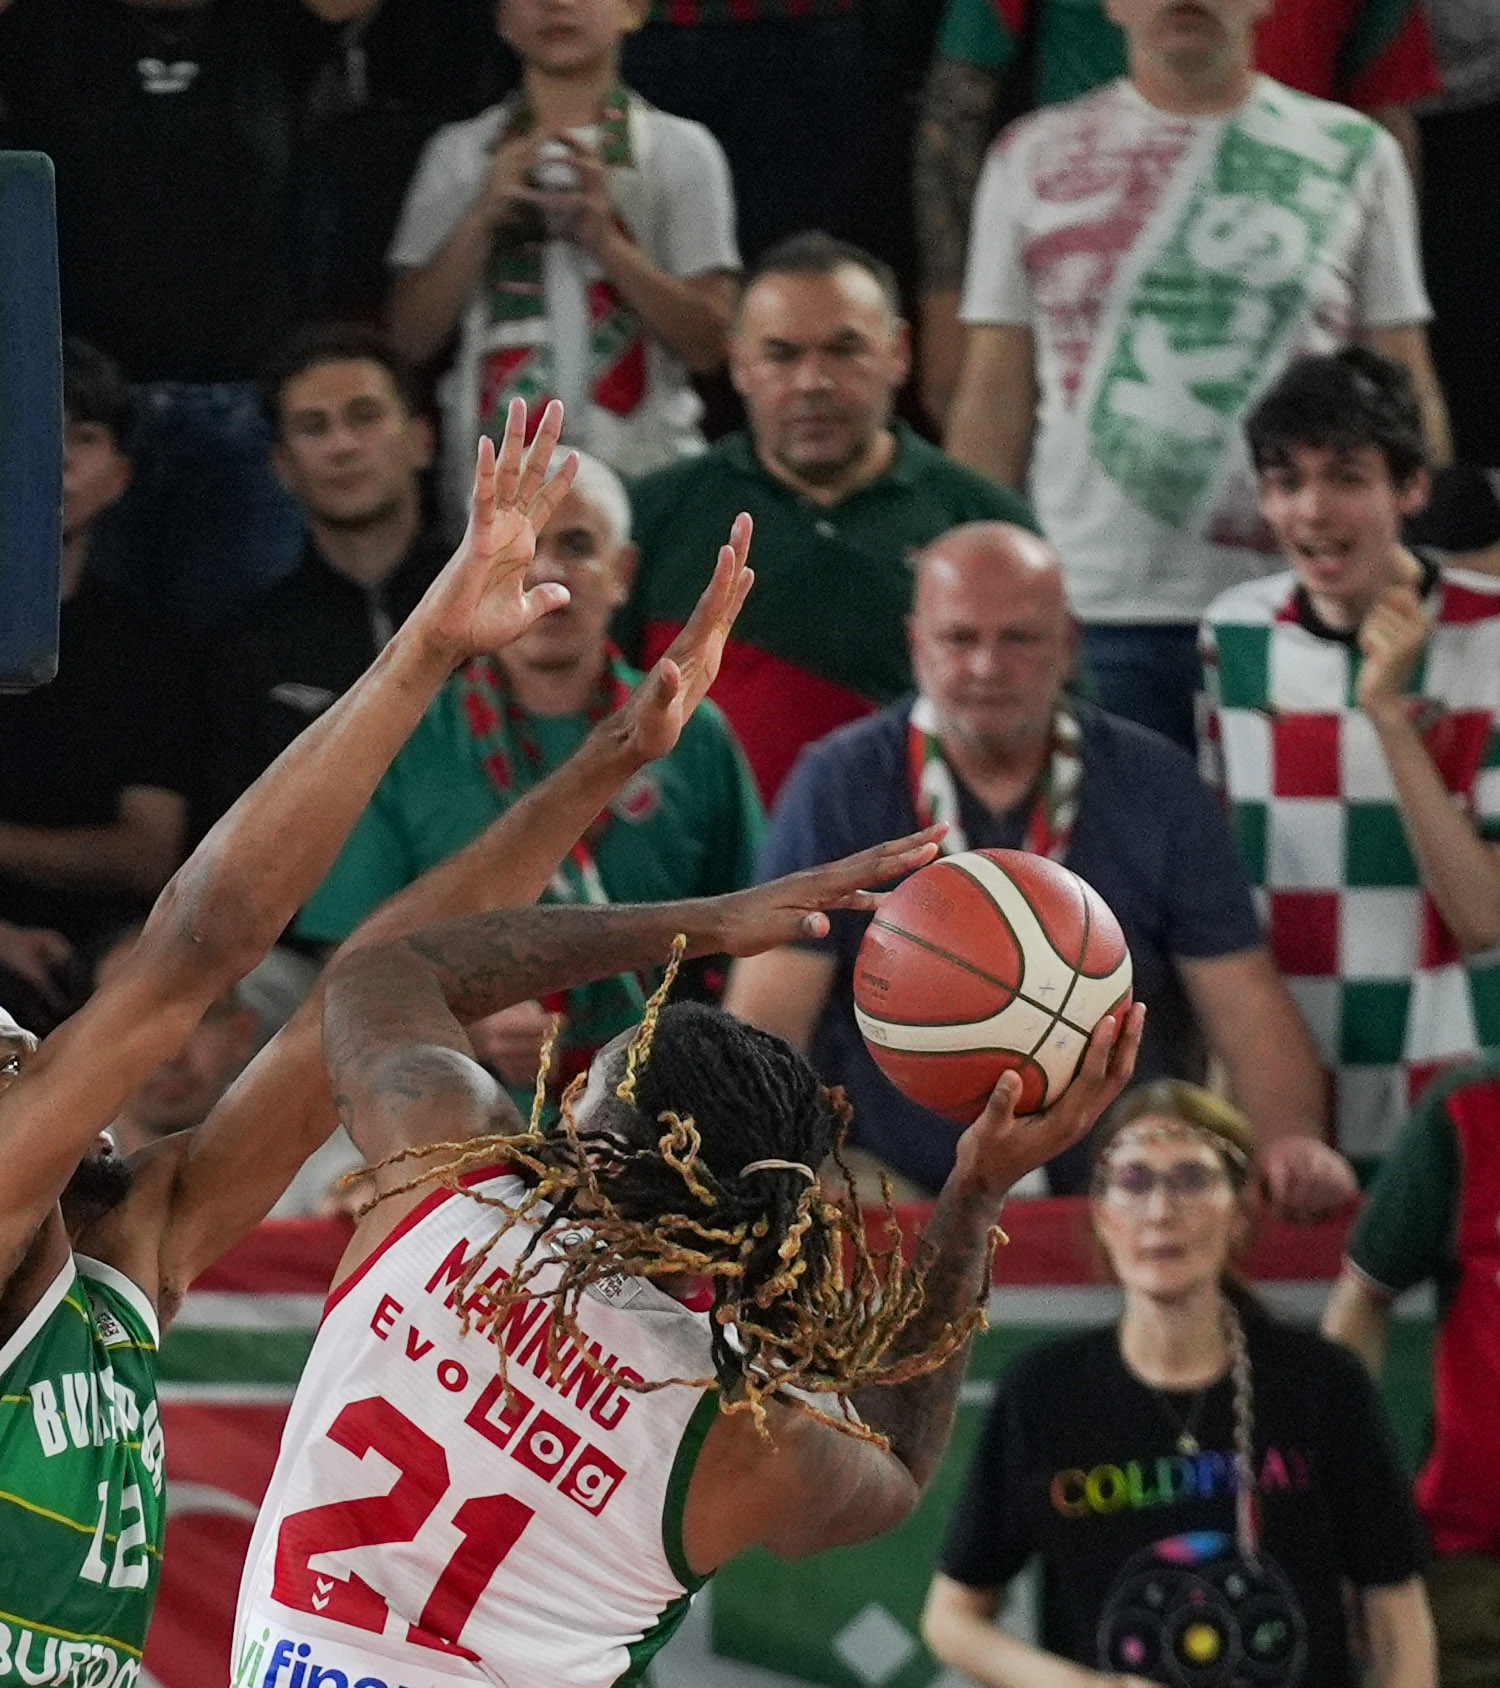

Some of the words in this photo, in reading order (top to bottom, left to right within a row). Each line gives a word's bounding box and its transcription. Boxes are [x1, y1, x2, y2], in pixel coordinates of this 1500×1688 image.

[424, 1237, 646, 1432] MANNING
[78, 1478, 150, 1590] 12
[271, 1396, 536, 1662] 21
